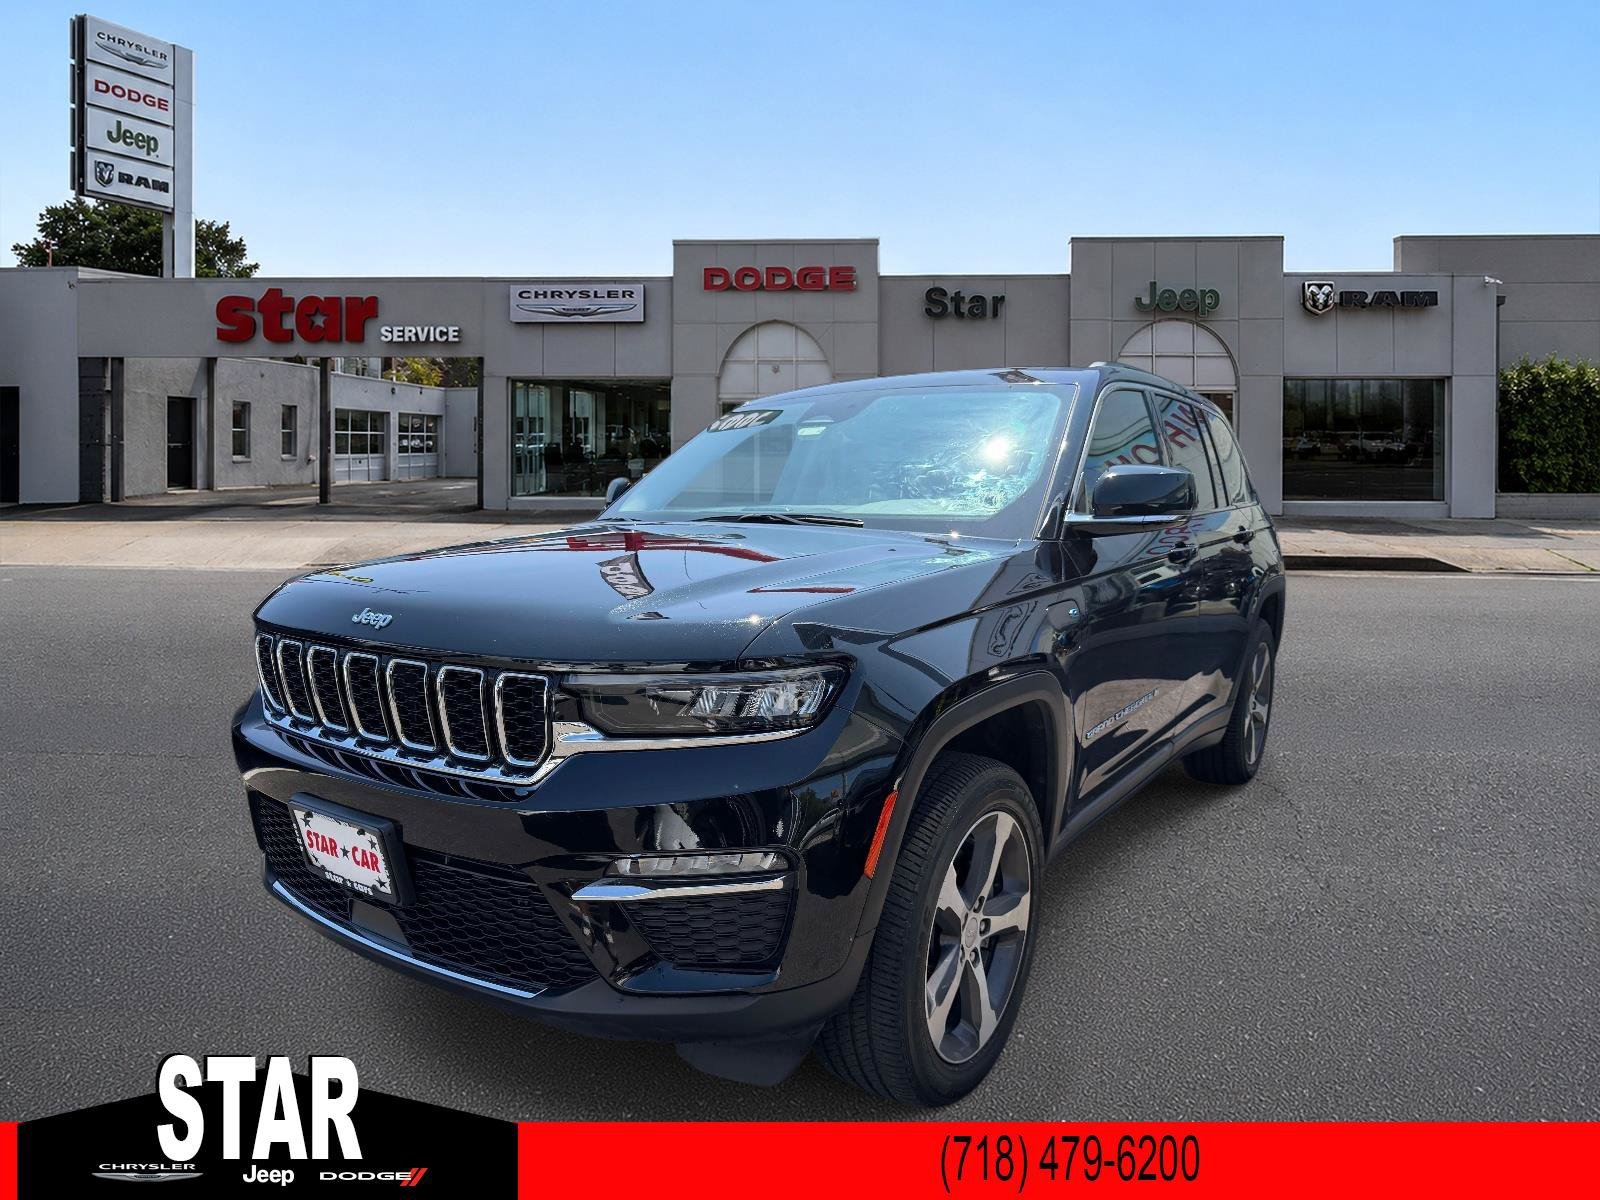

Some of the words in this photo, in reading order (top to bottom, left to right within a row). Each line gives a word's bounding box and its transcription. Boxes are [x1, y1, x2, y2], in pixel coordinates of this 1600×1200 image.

[97, 31, 168, 61] CHRYSLER
[94, 79, 169, 112] DODGE
[106, 120, 159, 156] Jeep
[118, 171, 170, 193] RAM
[703, 266, 857, 292] DODGE
[518, 290, 635, 299] CHRYSLER
[923, 287, 1006, 320] Star
[1134, 280, 1221, 317] Jeep
[1339, 290, 1439, 308] RAM
[216, 287, 379, 343] star
[380, 325, 461, 343] SERVICE
[351, 607, 393, 630] Jeep
[306, 829, 340, 859] STAR
[351, 845, 382, 874] CAR
